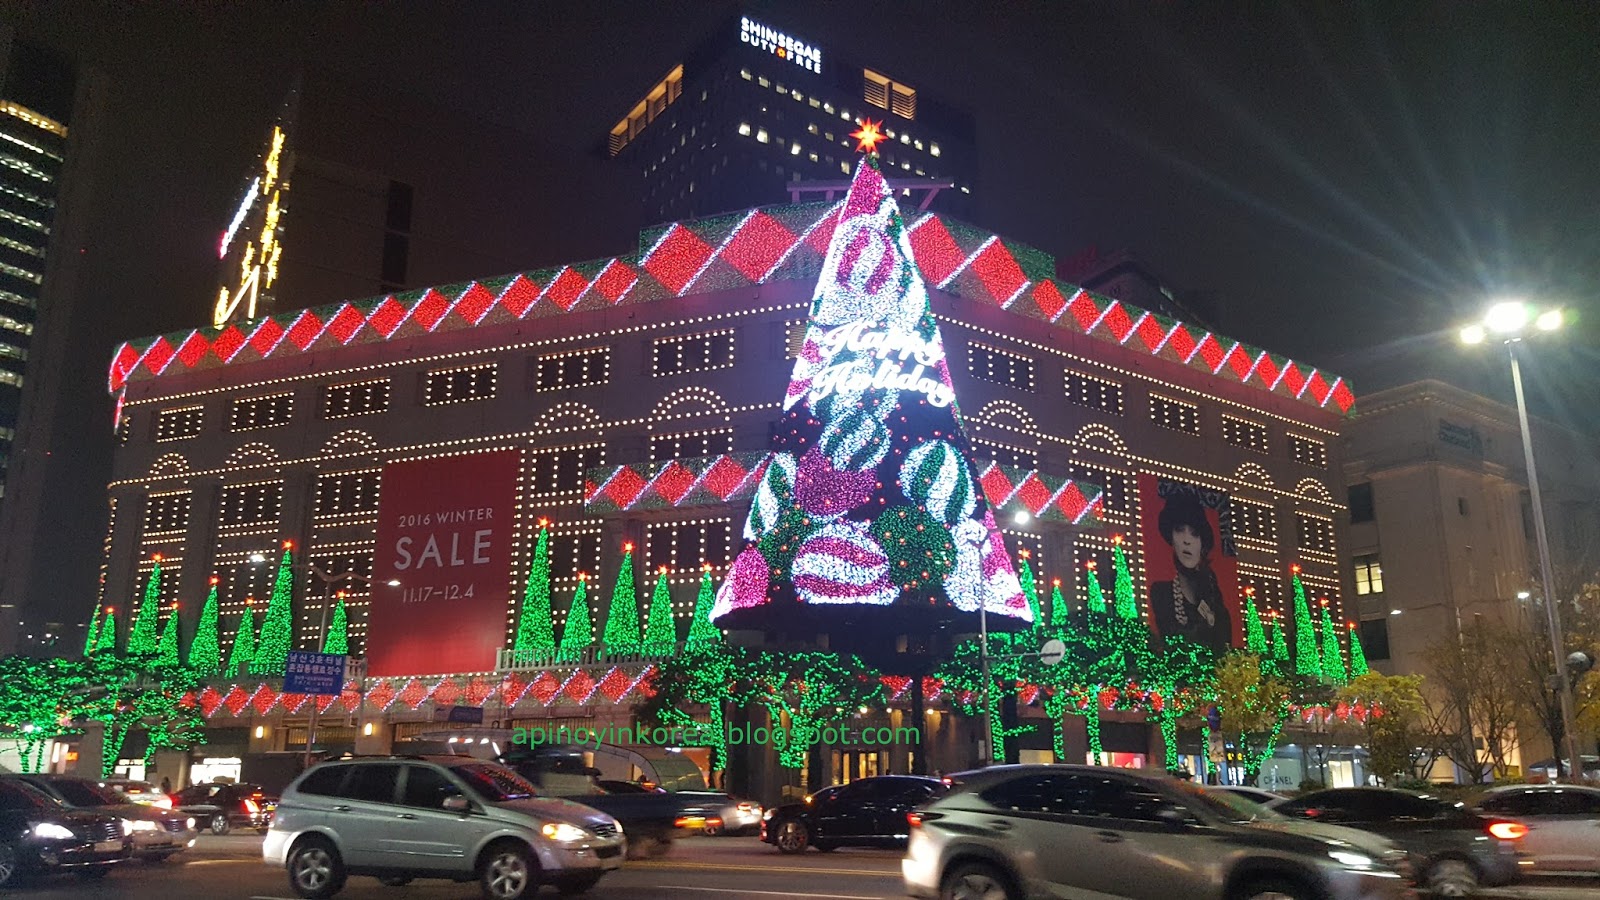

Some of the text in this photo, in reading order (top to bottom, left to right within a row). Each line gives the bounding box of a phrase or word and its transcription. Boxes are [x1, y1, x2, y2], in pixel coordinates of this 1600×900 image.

[741, 17, 821, 63] SHINSEGAE
[741, 31, 821, 74] DUTY FREE
[399, 508, 493, 527] 2016 WINTER
[394, 529, 493, 570] SALE
